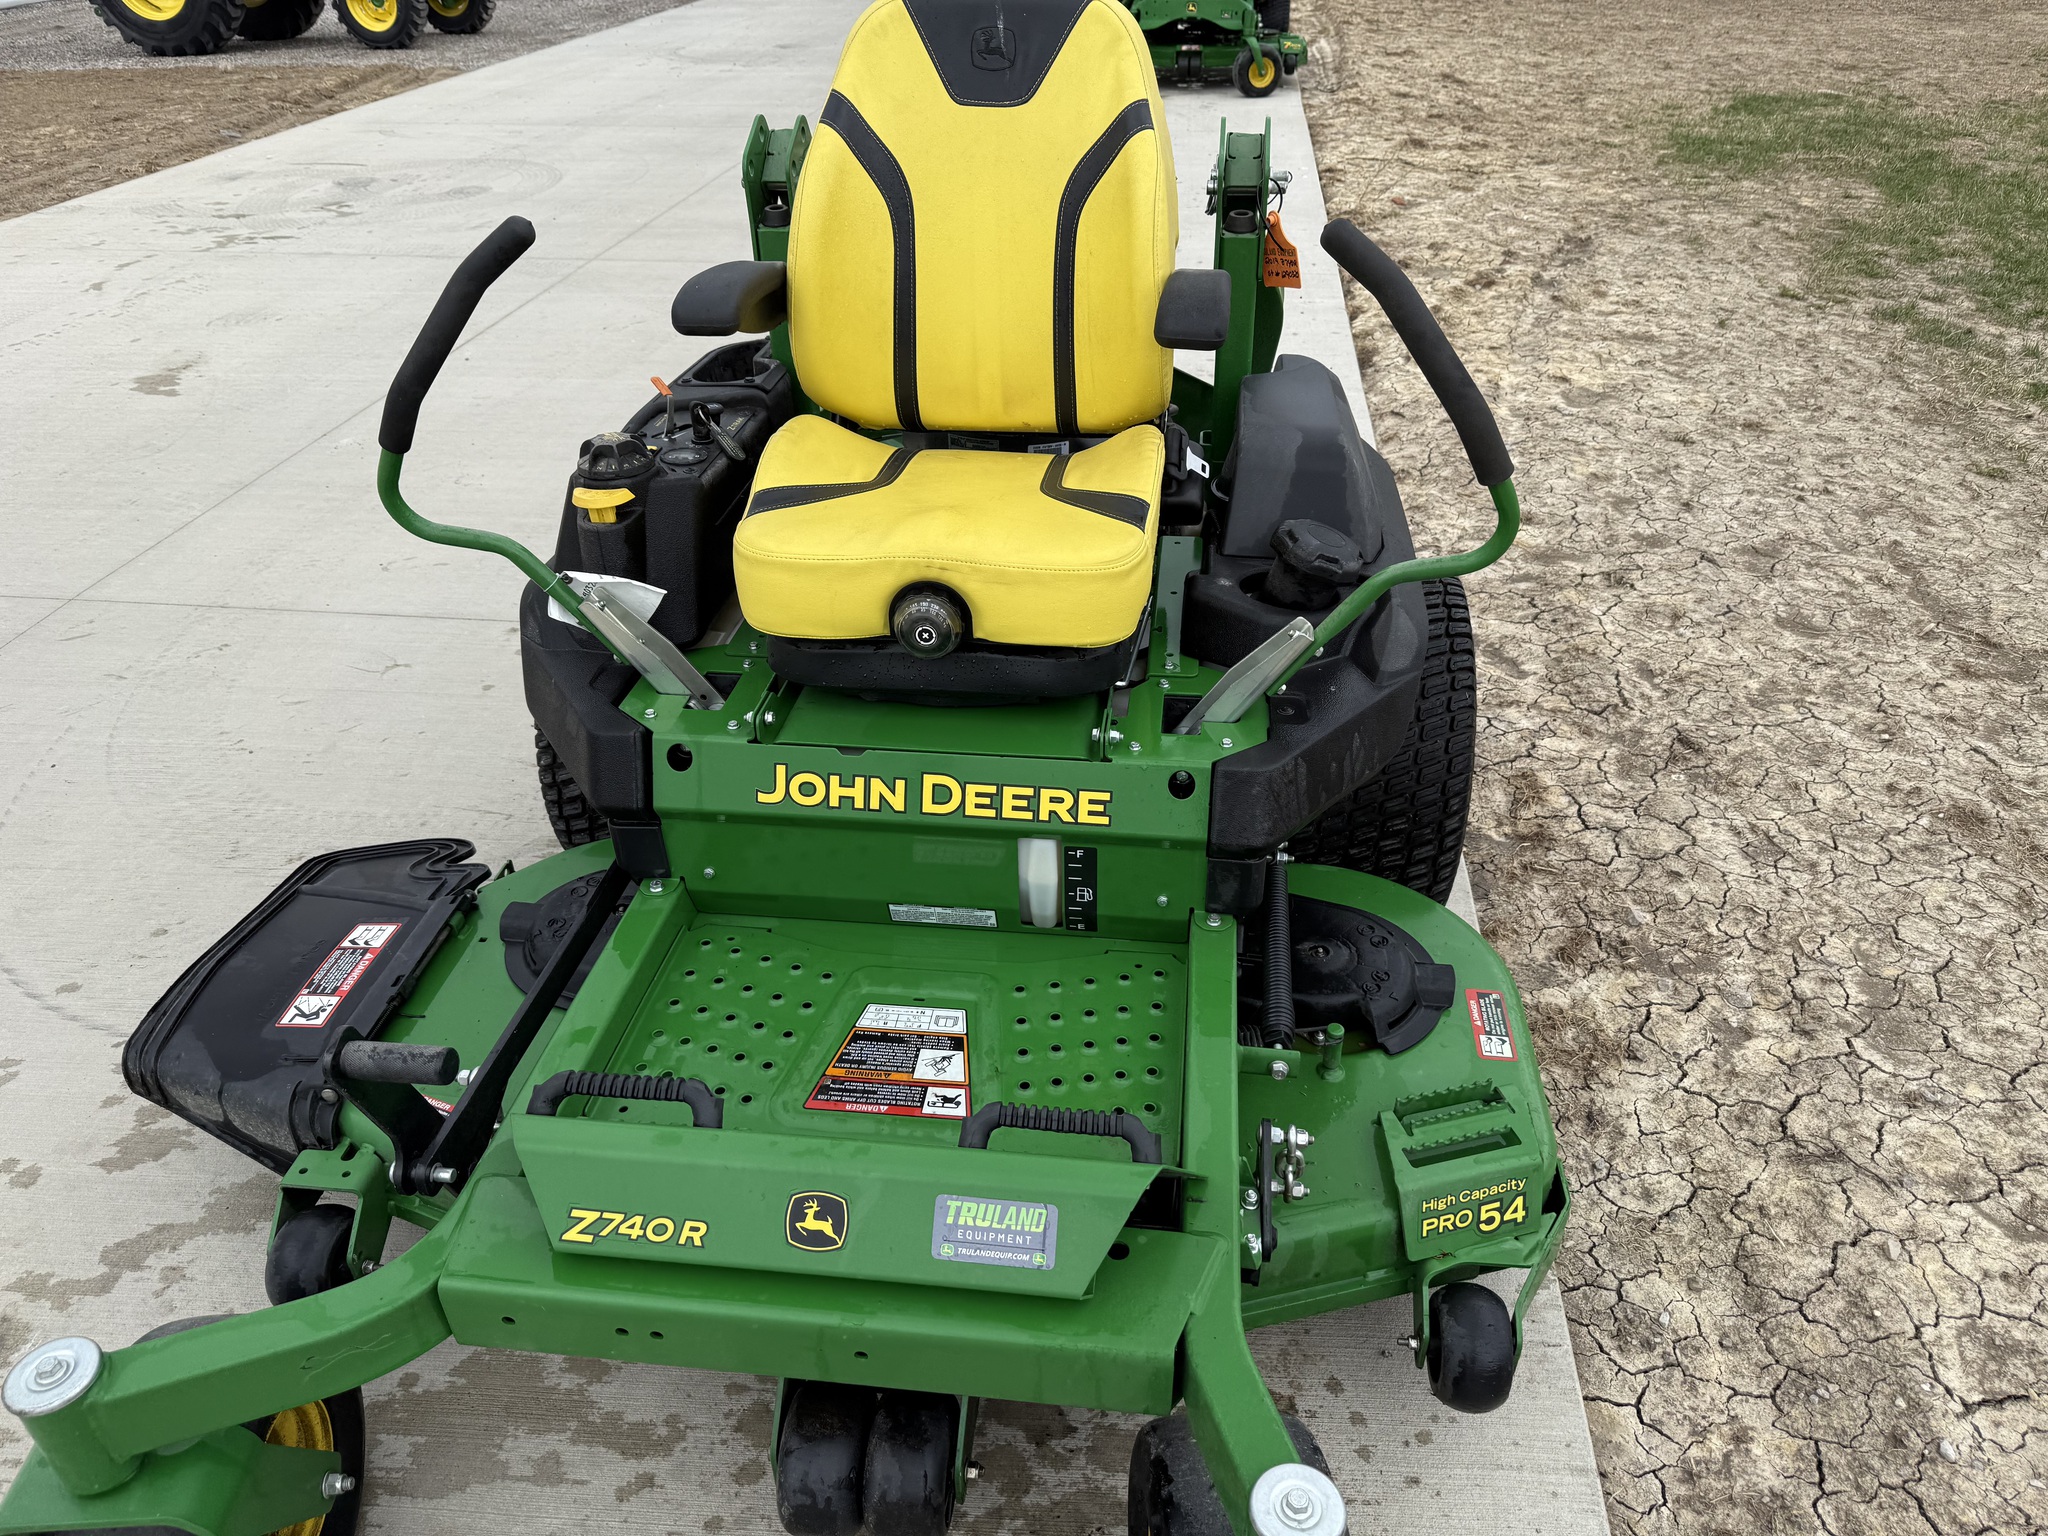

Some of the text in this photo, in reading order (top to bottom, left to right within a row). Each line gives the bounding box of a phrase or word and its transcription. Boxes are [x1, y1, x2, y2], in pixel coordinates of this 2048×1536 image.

[756, 763, 1112, 826] JOHN DEERE
[1076, 850, 1084, 858] F
[341, 960, 369, 992] DANGER
[1422, 1178, 1526, 1212] High Capacity
[946, 1200, 1048, 1232] TRULAND
[1422, 1195, 1526, 1238] PRO 54
[958, 1230, 1032, 1245] EQUIPMENT
[958, 1248, 1030, 1261] TRULANDEQUIP.COM
